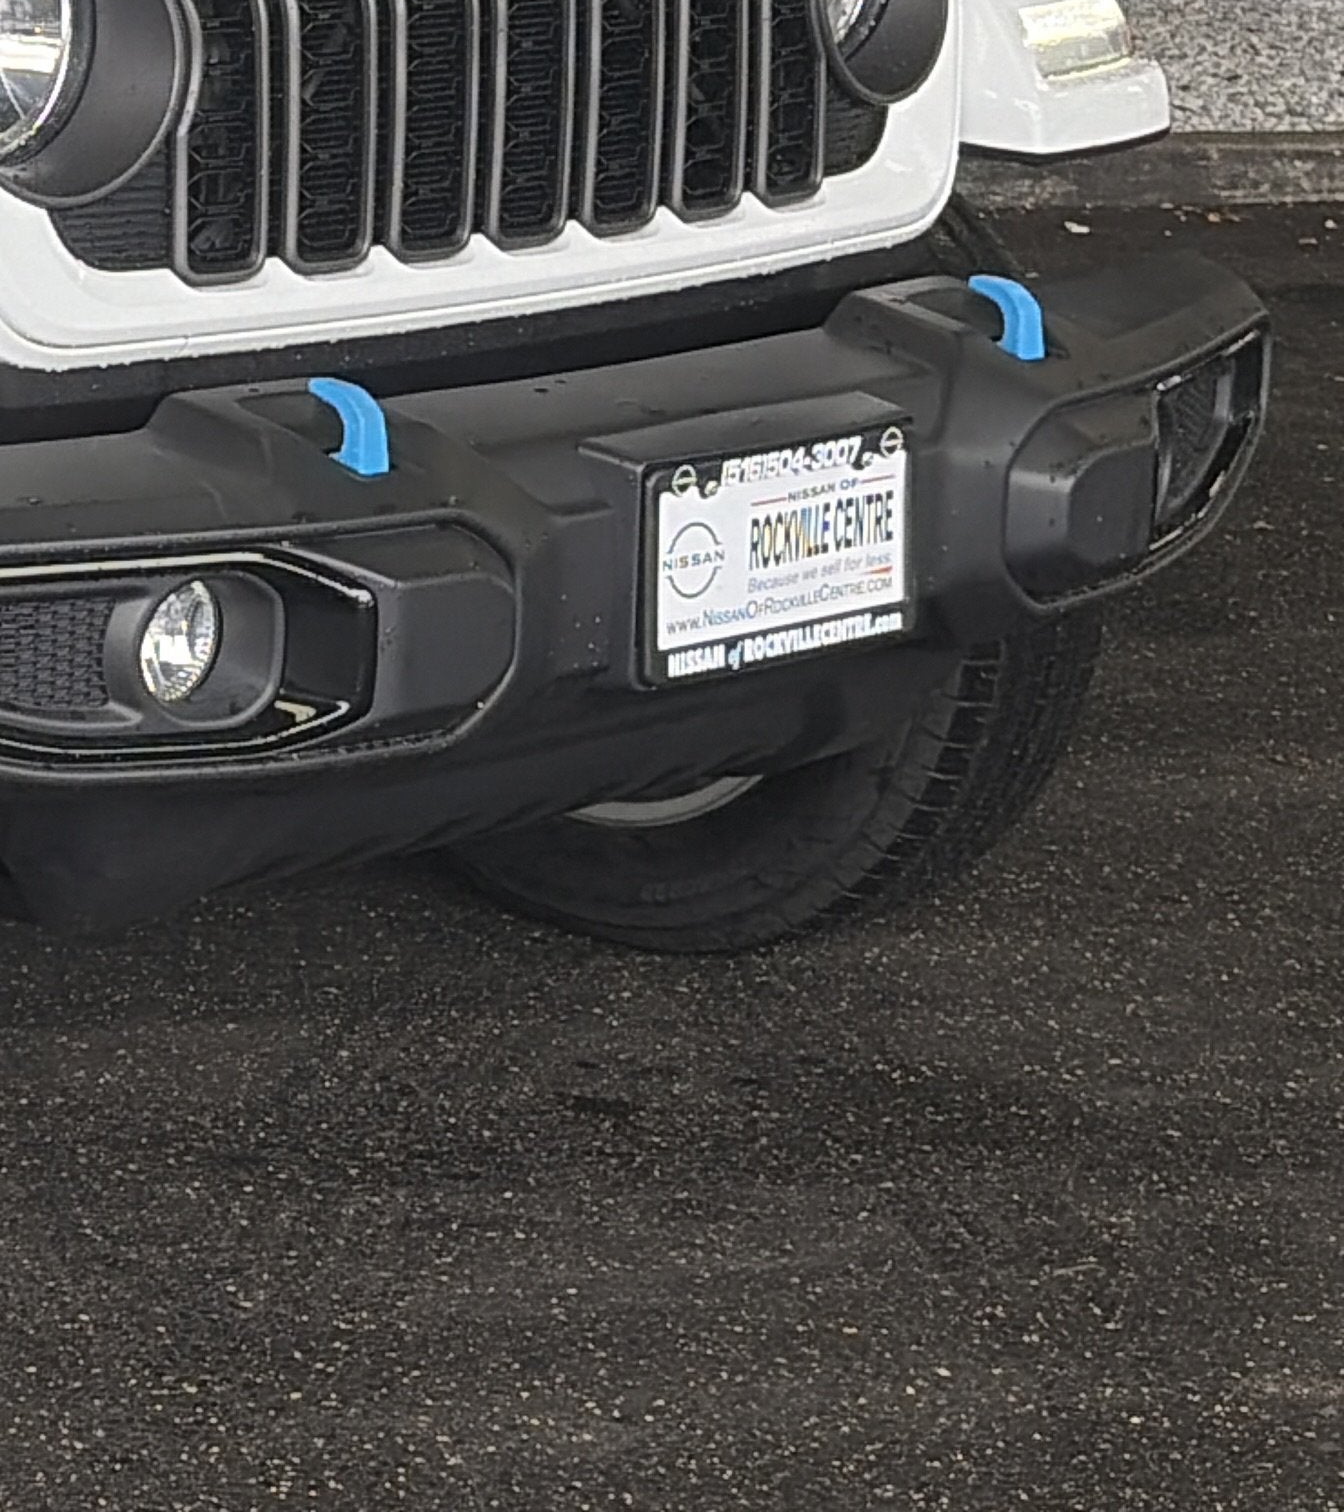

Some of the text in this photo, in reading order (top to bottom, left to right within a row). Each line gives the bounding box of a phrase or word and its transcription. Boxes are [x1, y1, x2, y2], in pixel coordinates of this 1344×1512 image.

[787, 476, 860, 503] NISSAN OF
[748, 490, 894, 572] ROCKVILLE CENTRE
[662, 549, 725, 572] NISSAN
[746, 571, 799, 594] Because
[668, 642, 726, 678] NISSAN
[728, 639, 744, 671] of
